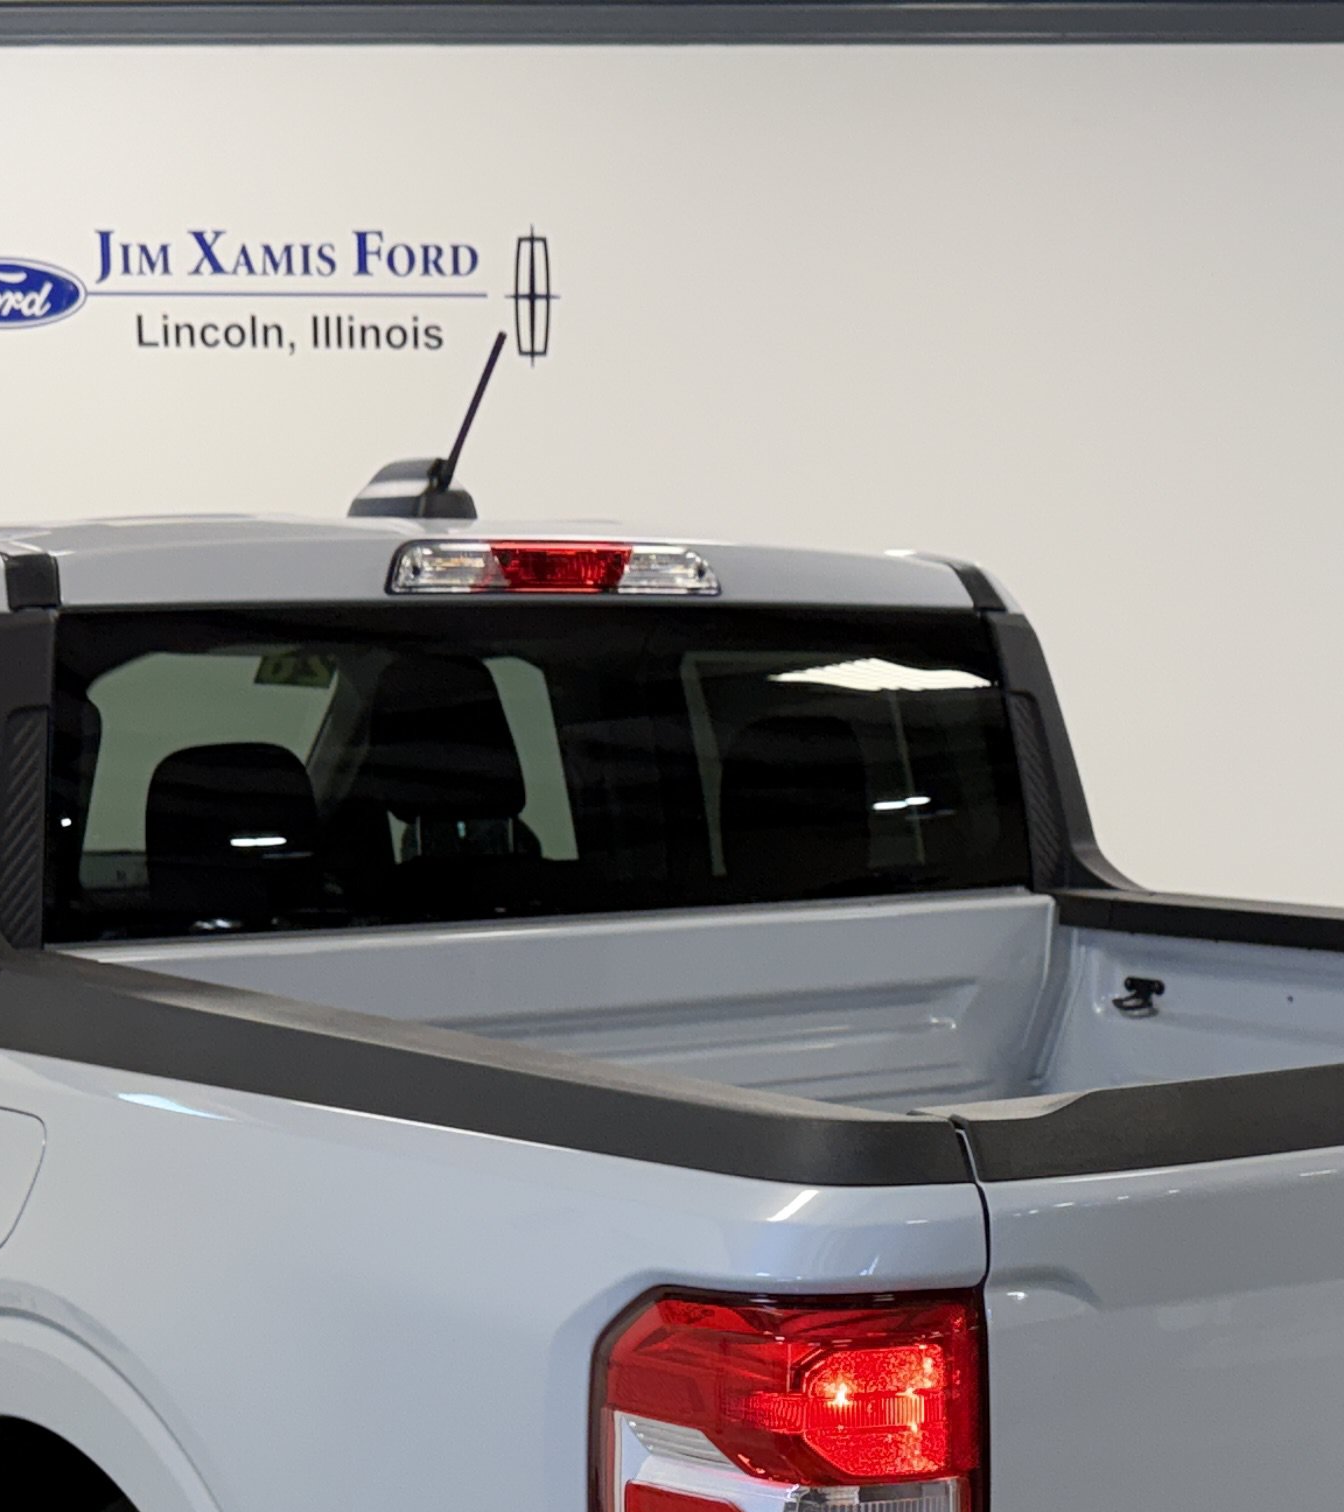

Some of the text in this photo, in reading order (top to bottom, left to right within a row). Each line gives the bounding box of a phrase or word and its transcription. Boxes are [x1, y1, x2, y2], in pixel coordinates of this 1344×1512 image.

[95, 230, 479, 284] JIM XAMIS FORD
[136, 315, 444, 355] Lincoln, Illinois
